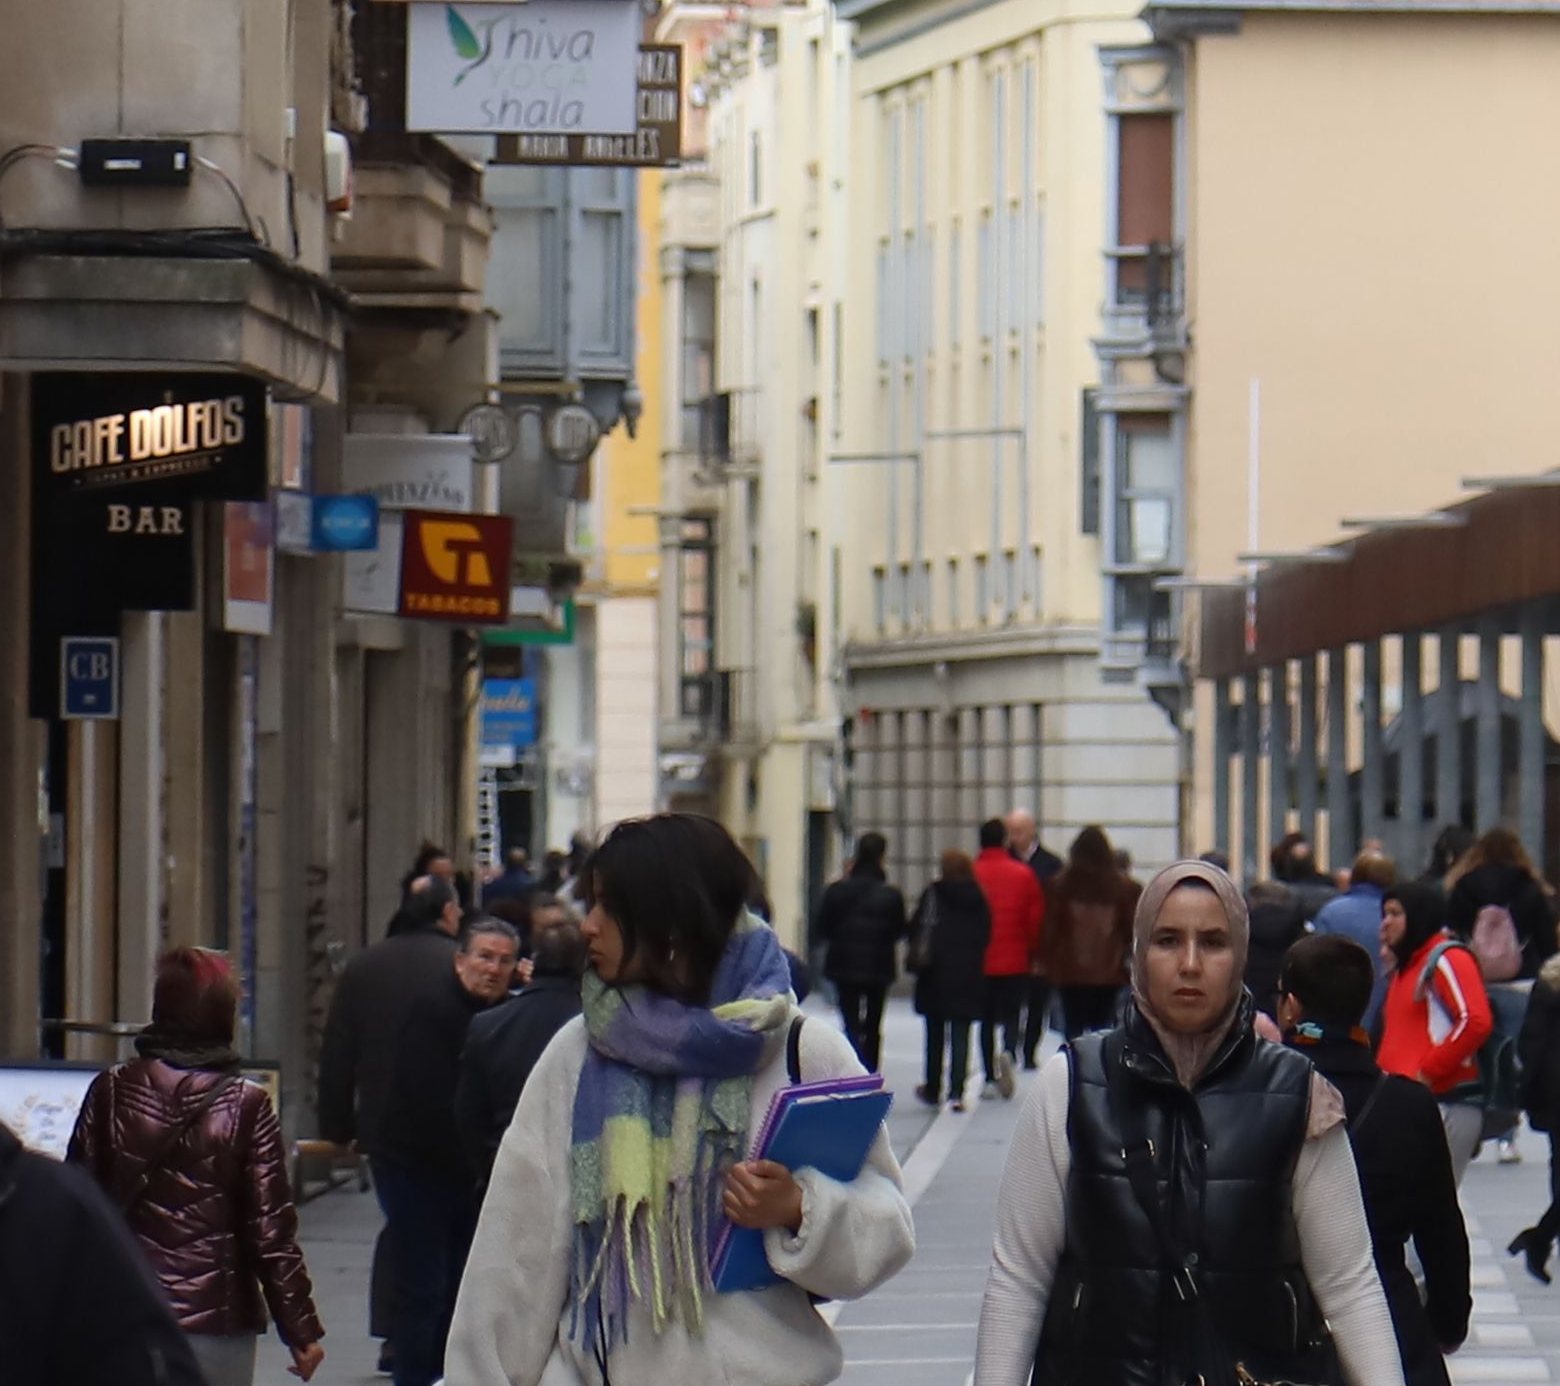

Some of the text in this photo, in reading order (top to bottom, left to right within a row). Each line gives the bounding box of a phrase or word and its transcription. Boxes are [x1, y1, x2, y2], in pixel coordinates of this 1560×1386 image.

[489, 62, 588, 90] YOGA
[129, 396, 246, 461] DOLFOS
[107, 503, 184, 536] BAR
[406, 592, 501, 616] TABACOS
[70, 651, 109, 680] CB
